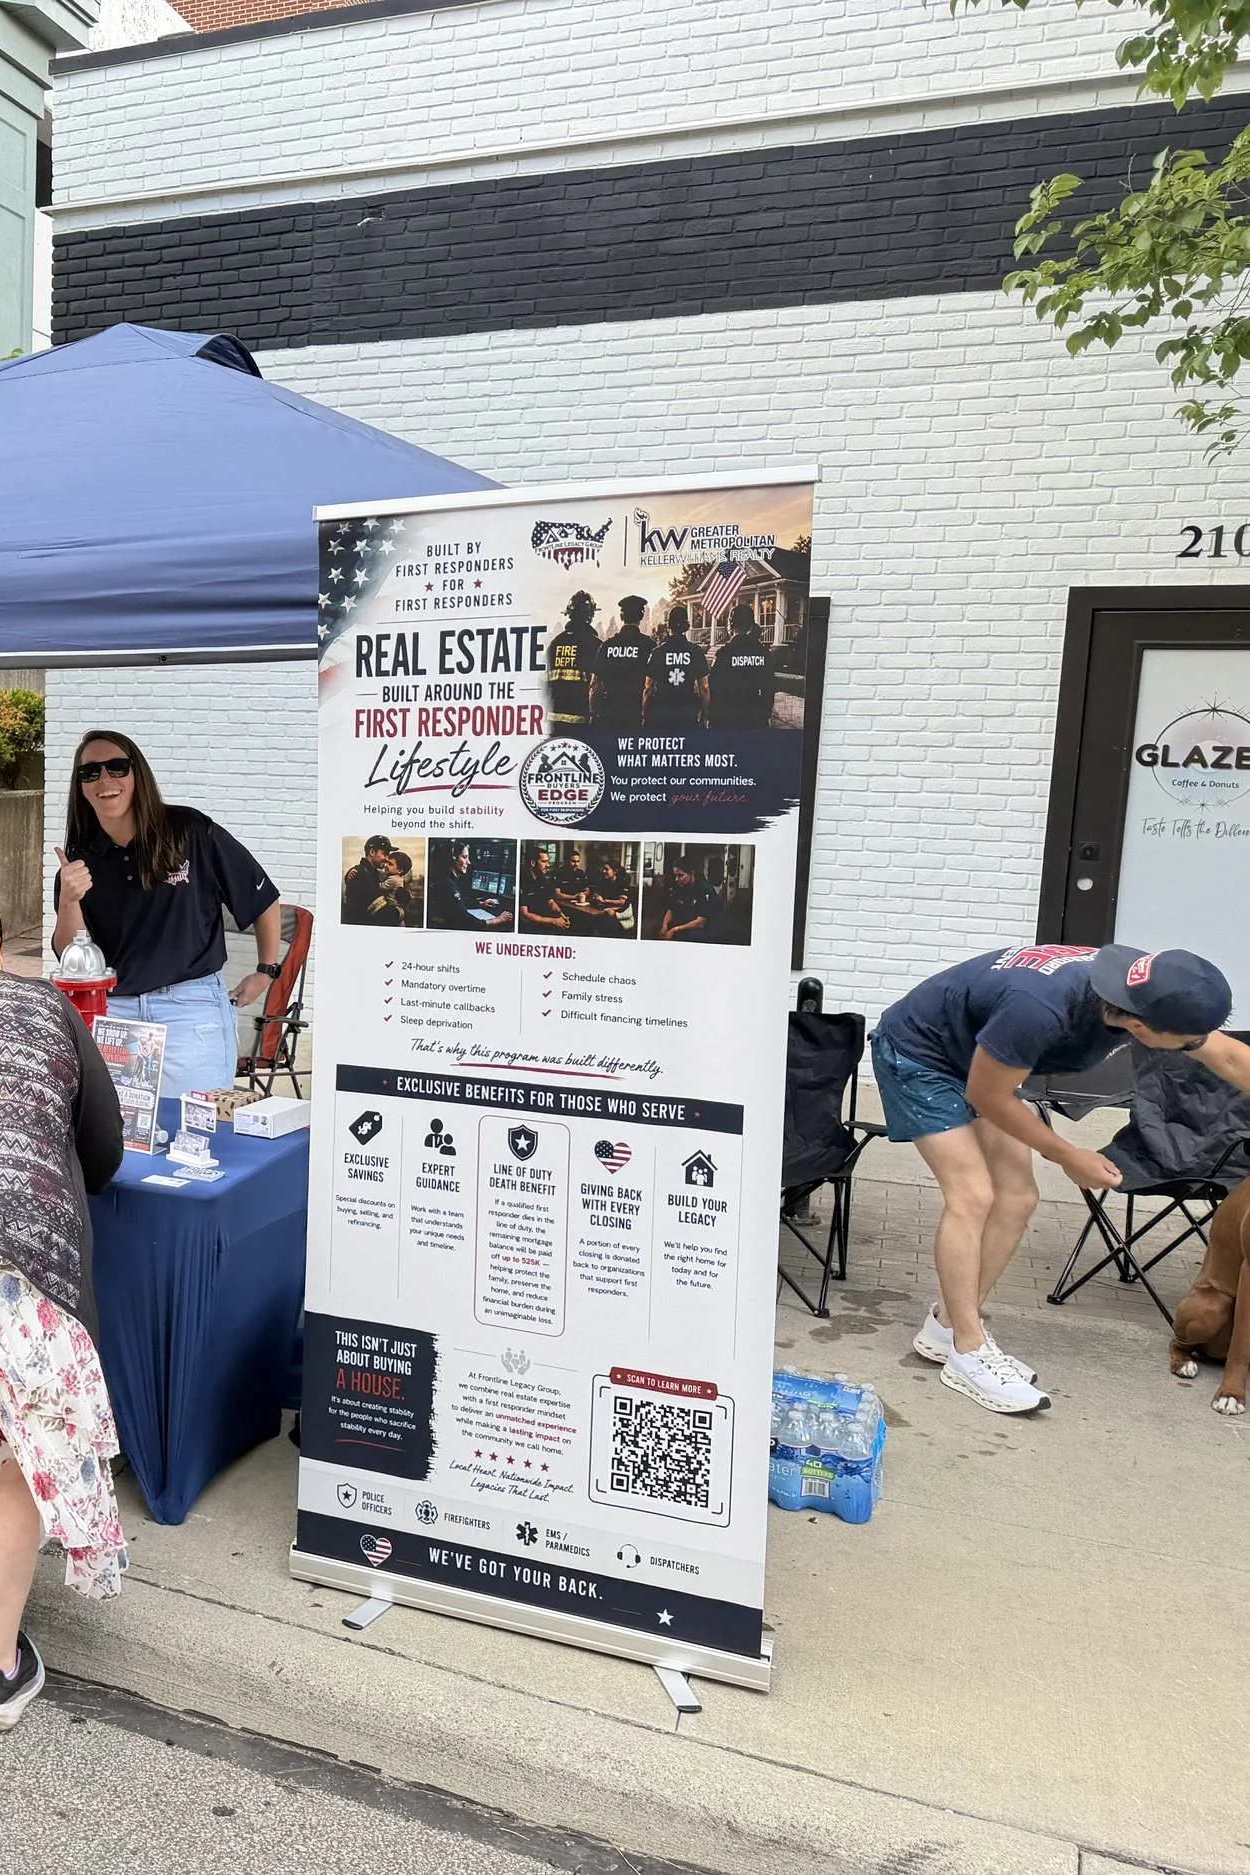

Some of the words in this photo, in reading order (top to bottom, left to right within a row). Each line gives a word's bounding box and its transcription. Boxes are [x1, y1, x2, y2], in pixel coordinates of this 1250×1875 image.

[641, 520, 689, 552] kw
[691, 525, 738, 537] GREATER
[427, 544, 460, 557] BUILT
[467, 542, 481, 554] BY
[535, 543, 564, 554] FRONTLINE
[691, 535, 774, 550] METROPOLITAN
[730, 548, 775, 561] REALTY
[396, 564, 428, 577] FIRST
[435, 558, 514, 575] RESPONDERS
[443, 579, 464, 591] FOR
[395, 598, 427, 611] FIRST
[434, 593, 512, 609] RESPONDERS
[356, 632, 426, 677] REAL
[439, 626, 547, 674] ESTATE
[556, 645, 577, 656] FIRE
[607, 647, 638, 658] POLICE
[555, 657, 576, 667] DEPT.
[666, 652, 690, 665] EMS
[732, 656, 764, 666] DISPATCH
[383, 685, 419, 702] BUILT
[425, 683, 482, 701] AROUND
[489, 682, 514, 699] THE
[355, 708, 410, 738] FIRST
[418, 705, 543, 737] RESPONDER
[618, 738, 634, 750] WE
[638, 737, 685, 750] PROTECT
[617, 755, 647, 767] WHAT
[652, 755, 701, 767] MATTERS
[705, 754, 738, 767] MOST.
[364, 740, 518, 797] Lifestyle
[528, 773, 599, 783] FRONTLINE
[611, 776, 627, 785] You
[631, 776, 667, 787] protect
[689, 776, 756, 786] communities.
[1172, 778, 1198, 789] Coffee
[1210, 780, 1239, 789] Donuts
[538, 789, 588, 800] EDGE
[611, 793, 626, 801] We
[629, 793, 666, 803] protect
[669, 794, 701, 807] your
[363, 805, 402, 815] Helping
[407, 807, 424, 815] you
[429, 806, 454, 815] build
[460, 806, 504, 816] stability
[391, 820, 426, 829] beyond
[430, 820, 445, 828] the
[449, 820, 474, 828] shift.
[1142, 817, 1166, 837] Taste
[1171, 819, 1191, 838] Tells
[1195, 819, 1210, 839] the
[475, 942, 492, 954] WE
[496, 942, 576, 960] UNDERSTAND:
[402, 962, 434, 972] 24-hour
[437, 964, 460, 973] shifts
[562, 972, 605, 983] Schedule
[608, 975, 636, 985] chaos
[401, 980, 446, 992] Mandatory
[448, 984, 486, 993] overtime
[561, 991, 592, 1002] Family
[596, 994, 623, 1003] stress
[401, 998, 450, 1009] Last-minute
[454, 1004, 495, 1013] callbacks
[401, 1016, 423, 1026] Sleep
[426, 1019, 472, 1029] deprivation
[561, 1010, 597, 1021] Difficult
[600, 1013, 642, 1026] financing
[645, 1017, 688, 1027] timelines
[411, 1038, 443, 1053] That's
[446, 1042, 466, 1060] why
[470, 1044, 490, 1057] this
[491, 1051, 539, 1065] program
[542, 1055, 563, 1065] was
[565, 1053, 596, 1067] built
[597, 1056, 663, 1079] differently.
[397, 1076, 460, 1097] EXCLUSIVE
[466, 1084, 525, 1104] BENEFITS
[530, 1091, 554, 1108] FOR
[560, 1094, 602, 1112] THOSE
[608, 1098, 636, 1116] WHO
[642, 1102, 685, 1120] SERVE
[344, 1153, 389, 1169] EXCLUSIVE
[348, 1169, 384, 1183] SAVINGS
[422, 1163, 455, 1177] EXPERT
[494, 1163, 514, 1176] LINE
[516, 1166, 527, 1177] OF
[530, 1168, 552, 1181] DUTY
[416, 1177, 460, 1193] GUIDANCE
[489, 1177, 517, 1192] DEATH
[520, 1181, 556, 1196] BENEFIT
[581, 1183, 614, 1198] GIVING
[617, 1187, 642, 1201] BACK
[582, 1199, 607, 1212] WITH
[610, 1202, 640, 1216] EVERY
[668, 1195, 698, 1209] BUILD
[702, 1198, 728, 1213] YOUR
[590, 1215, 631, 1230] CLOSING
[678, 1211, 716, 1227] LEGACY
[335, 1331, 358, 1347] THIS
[362, 1335, 388, 1352] ISN'T
[391, 1341, 417, 1358] JUST
[336, 1349, 370, 1368] ABOUT
[374, 1356, 412, 1375] BUYING
[336, 1368, 346, 1389] A
[351, 1370, 404, 1400] HOUSE.
[478, 1373, 508, 1385] Frontline
[510, 1380, 535, 1391] Legacy
[538, 1385, 561, 1396] Group,
[627, 1374, 644, 1384] SCAN
[647, 1378, 655, 1386] TO
[658, 1380, 679, 1391] LEARN
[682, 1385, 701, 1394] MORE
[362, 1491, 384, 1503] POLICE
[362, 1503, 392, 1515] OFFICERS
[444, 1513, 490, 1530] FIREFIGHTERS
[546, 1529, 560, 1540] EMS
[563, 1533, 567, 1541] /
[546, 1541, 590, 1557] PARAMEDICS
[650, 1556, 700, 1575] DISPATCHERS
[429, 1547, 472, 1571] WE'VE
[479, 1559, 506, 1578] GOT
[513, 1566, 551, 1588] YOUR
[559, 1576, 603, 1600] BACK.
